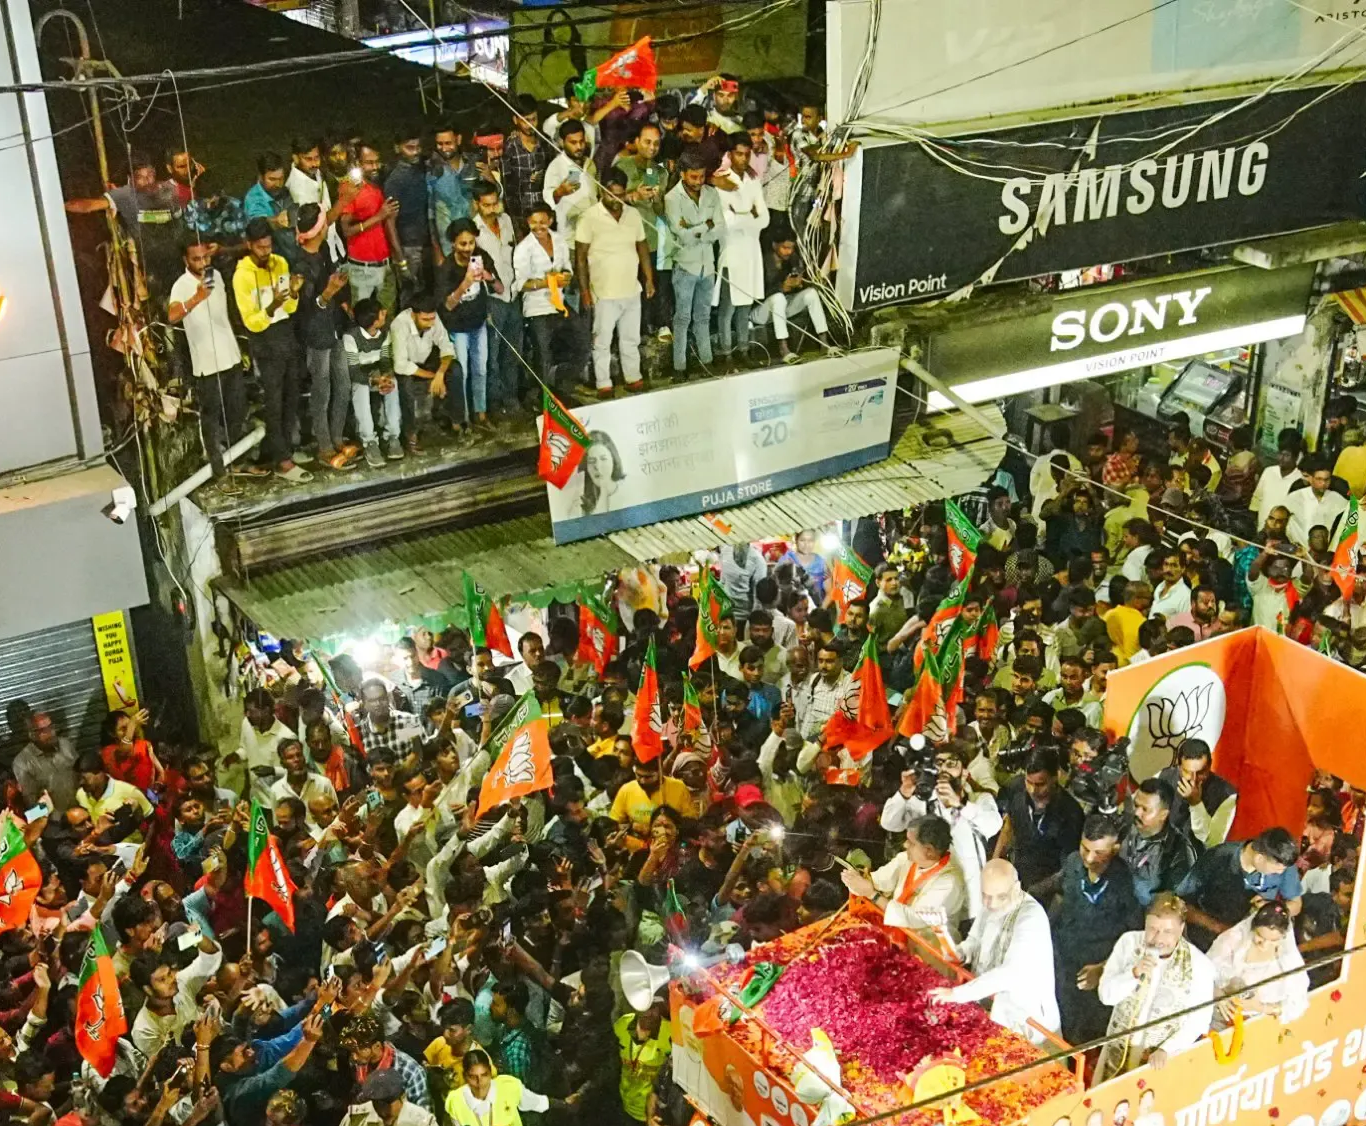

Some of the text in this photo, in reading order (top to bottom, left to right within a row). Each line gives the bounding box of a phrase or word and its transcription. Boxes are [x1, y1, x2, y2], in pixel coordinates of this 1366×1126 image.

[998, 141, 1270, 236] SAMSUNG
[859, 273, 948, 304] Vision Point
[1050, 287, 1212, 352] SONY
[1085, 346, 1166, 373] VISION POINT
[702, 479, 773, 507] PUJA STORE
[103, 639, 122, 649] HAPPY
[1283, 1036, 1339, 1095] रोड
